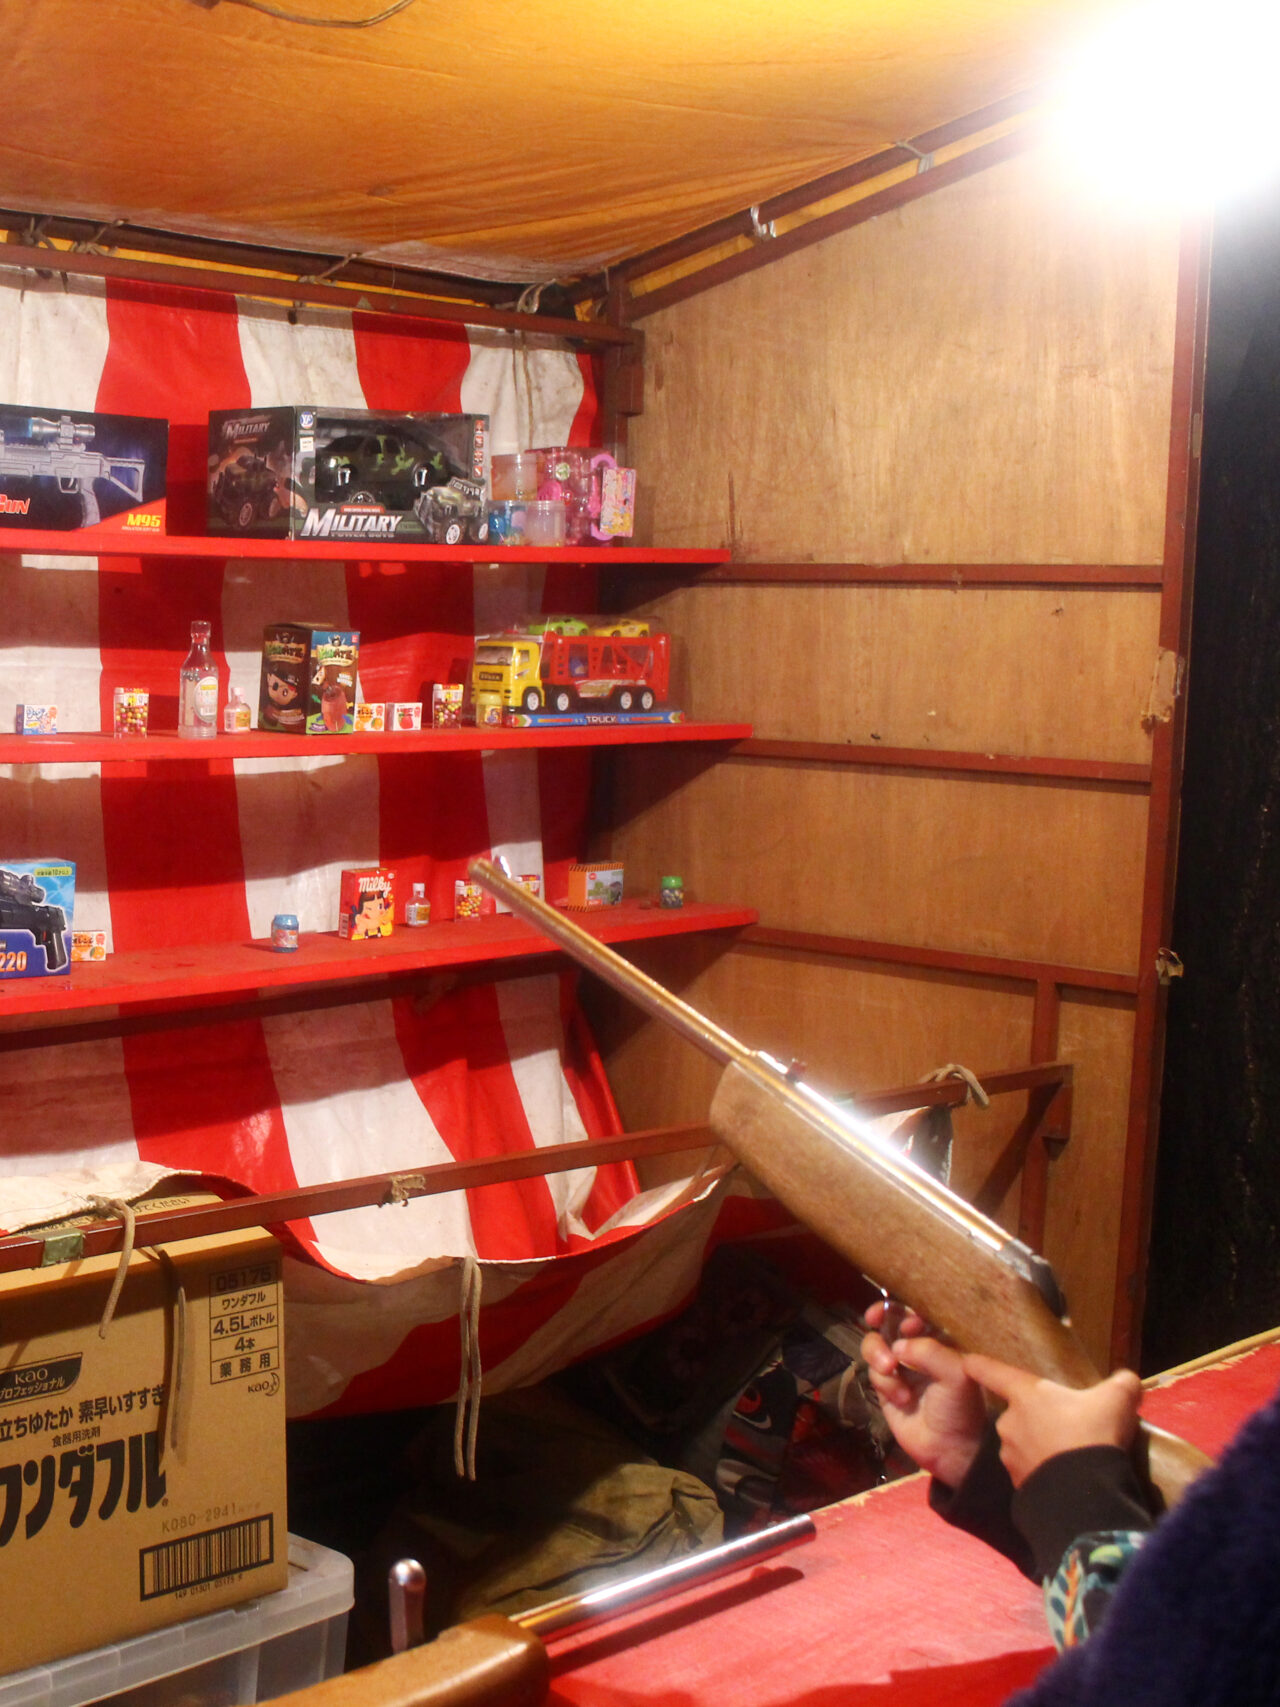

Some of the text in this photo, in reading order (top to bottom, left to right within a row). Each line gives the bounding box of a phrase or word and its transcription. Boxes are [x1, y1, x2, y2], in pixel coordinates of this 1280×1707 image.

[127, 513, 162, 528] M95
[585, 716, 617, 724] TRUCK
[358, 876, 392, 898] Milky
[222, 1291, 266, 1311] ワンダフル
[213, 1312, 275, 1335] 4.5Lボトル
[234, 1336, 256, 1352] 4本
[79, 1384, 165, 1424] 素早いすすぎ
[52, 1426, 101, 1449] 食器用洗剤
